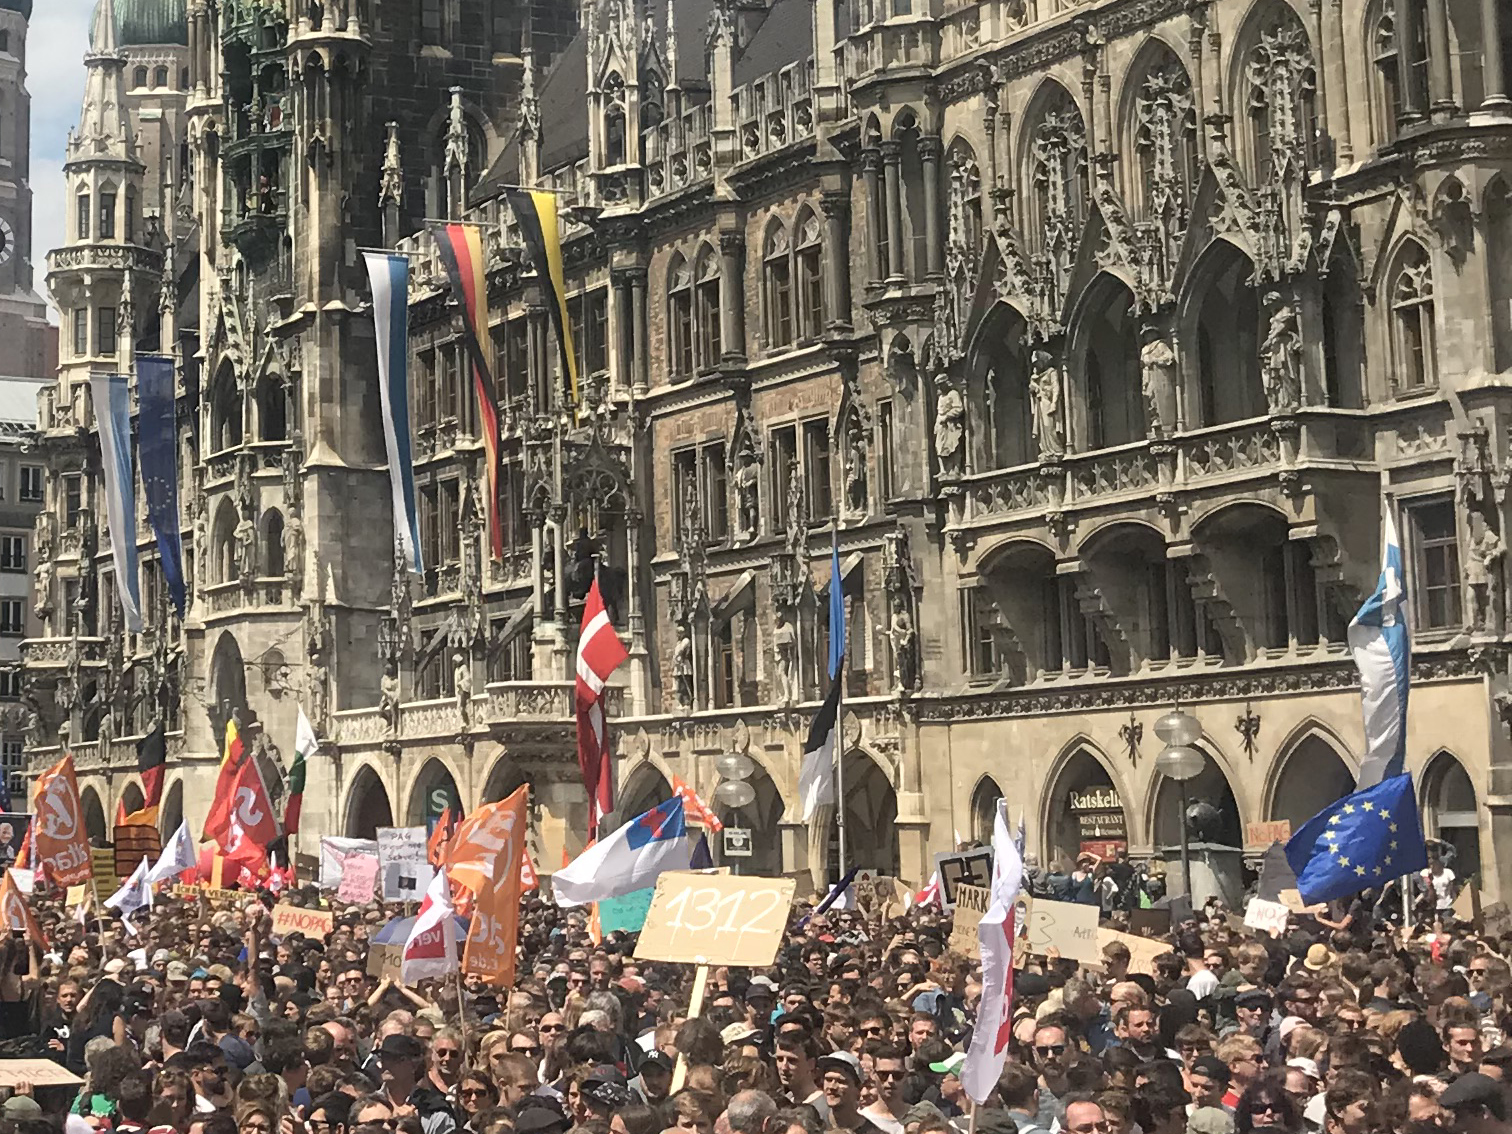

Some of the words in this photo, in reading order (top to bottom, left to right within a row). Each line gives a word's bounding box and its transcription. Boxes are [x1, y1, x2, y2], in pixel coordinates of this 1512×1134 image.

[431, 789, 449, 812] S
[391, 832, 412, 841] PAG
[665, 885, 781, 934] 1312
[277, 910, 333, 934] #NOPAG
